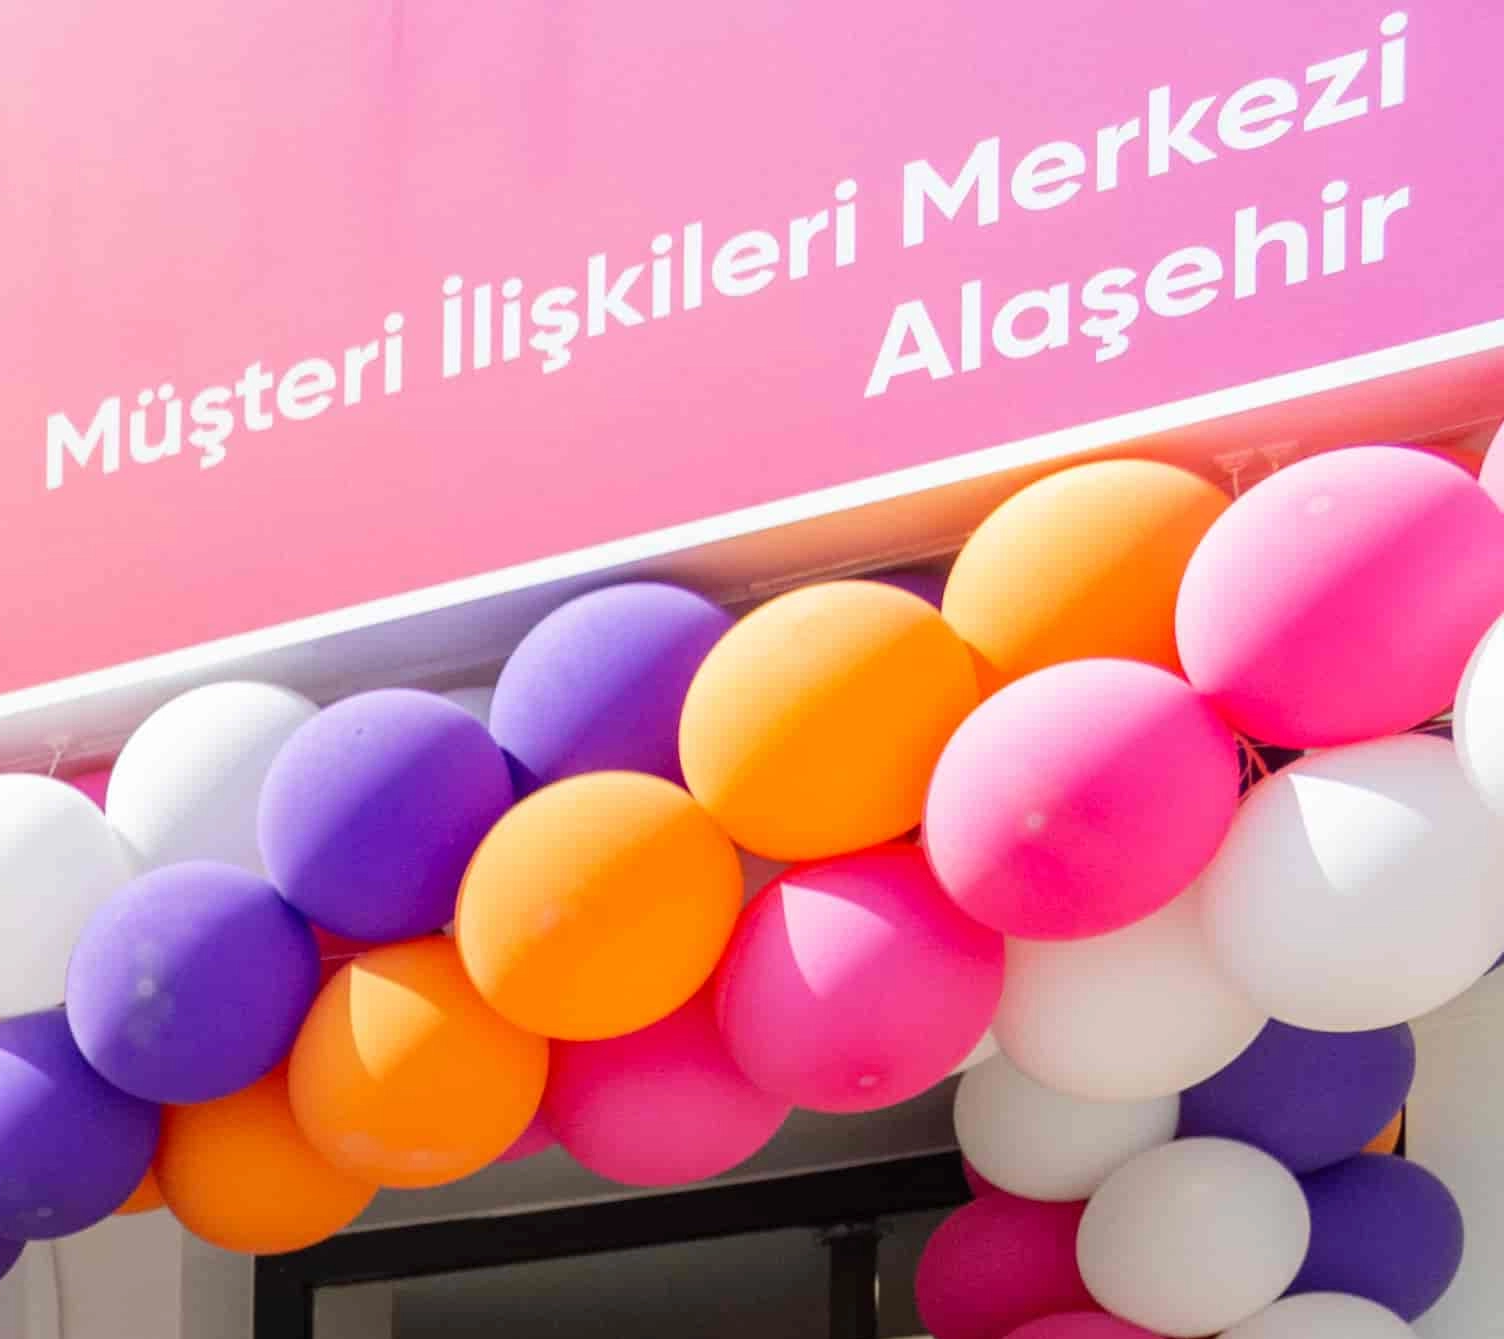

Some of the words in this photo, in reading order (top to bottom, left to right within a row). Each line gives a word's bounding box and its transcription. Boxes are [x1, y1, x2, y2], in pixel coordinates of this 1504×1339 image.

[45, 312, 406, 491] Müşteri
[441, 178, 859, 378] İlişkileri
[901, 10, 1409, 248] Merkezi
[862, 180, 1411, 399] Alaşehir
